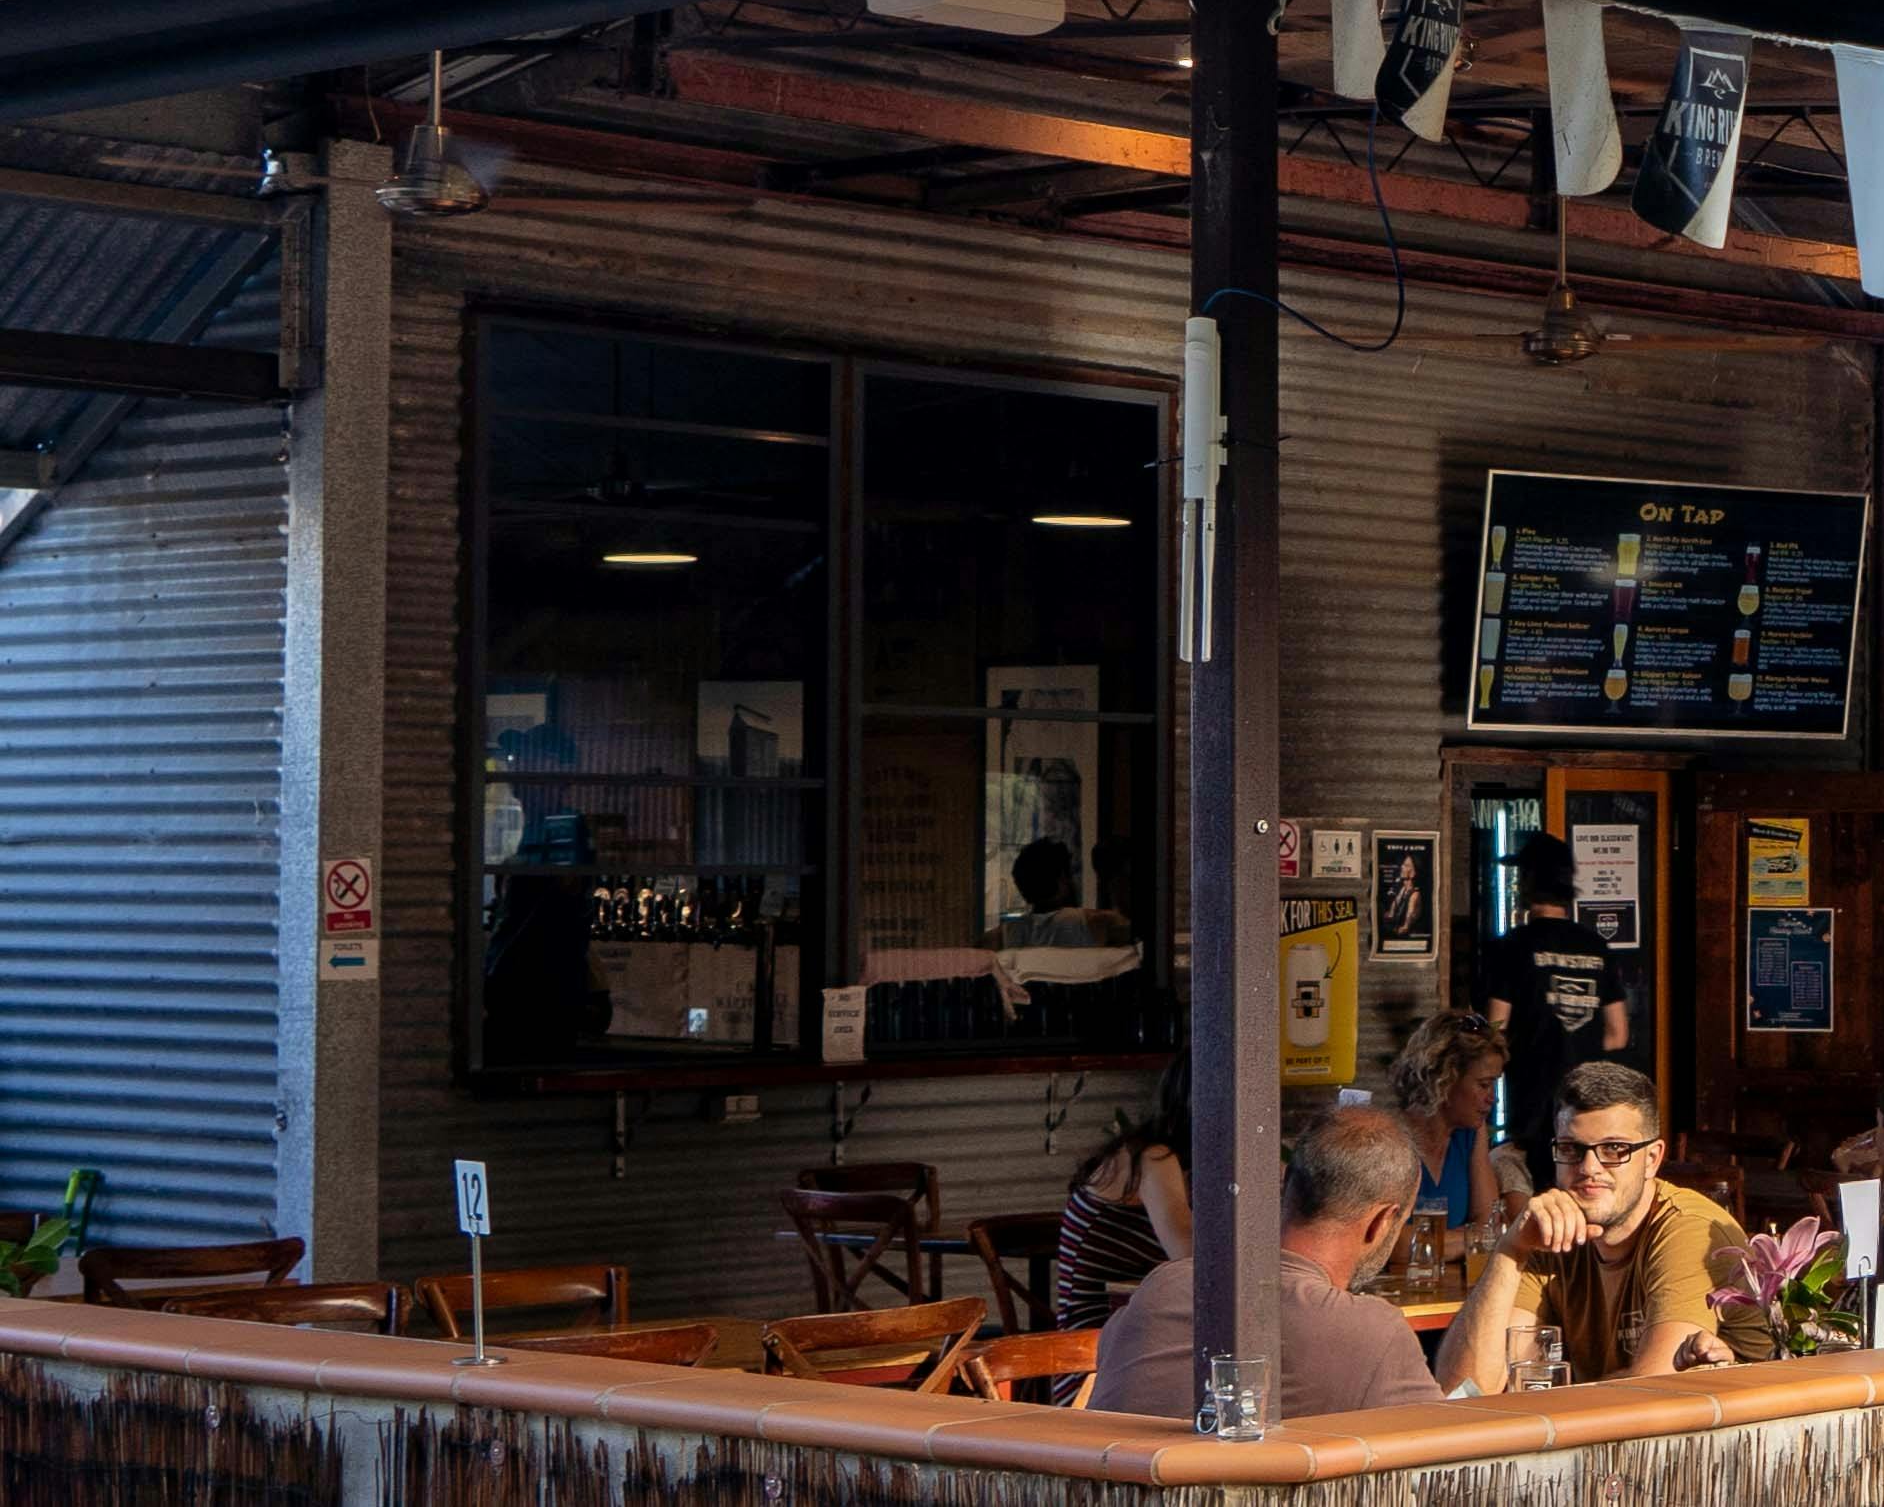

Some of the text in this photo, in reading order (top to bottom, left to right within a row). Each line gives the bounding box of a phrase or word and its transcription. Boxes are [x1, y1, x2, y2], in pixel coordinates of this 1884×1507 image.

[1400, 14, 1440, 53] KING
[1663, 99, 1715, 142] KING
[1290, 900, 1312, 930] FOR
[1312, 899, 1335, 925] THIS
[1335, 898, 1355, 919] SEAL
[462, 1172, 484, 1222] 12
